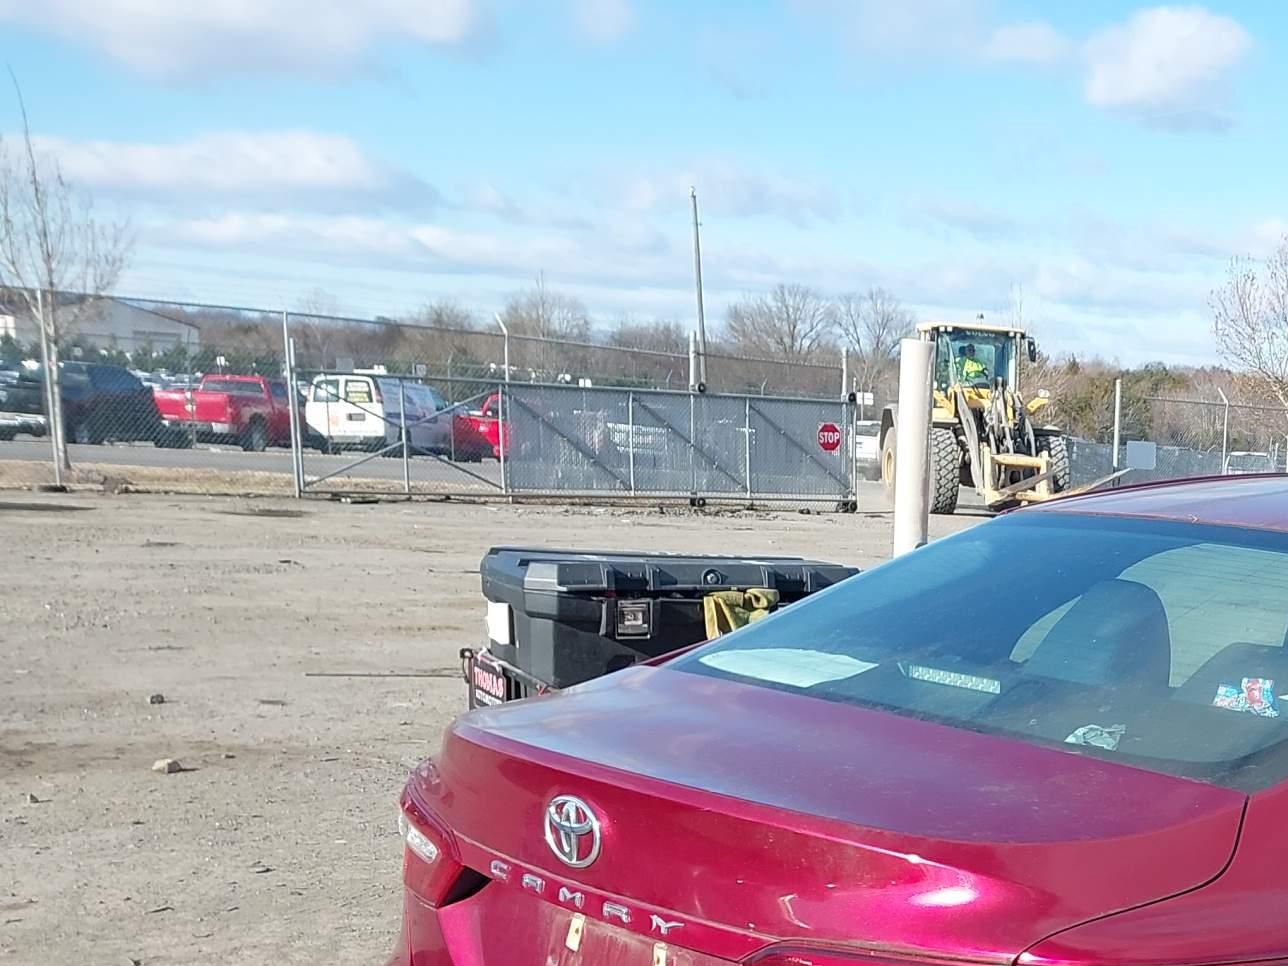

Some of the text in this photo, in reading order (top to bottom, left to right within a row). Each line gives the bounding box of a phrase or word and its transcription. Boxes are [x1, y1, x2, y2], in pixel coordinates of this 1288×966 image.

[819, 431, 840, 444] STOP
[474, 666, 504, 698] THOMAS
[490, 859, 685, 935] CAMRY
